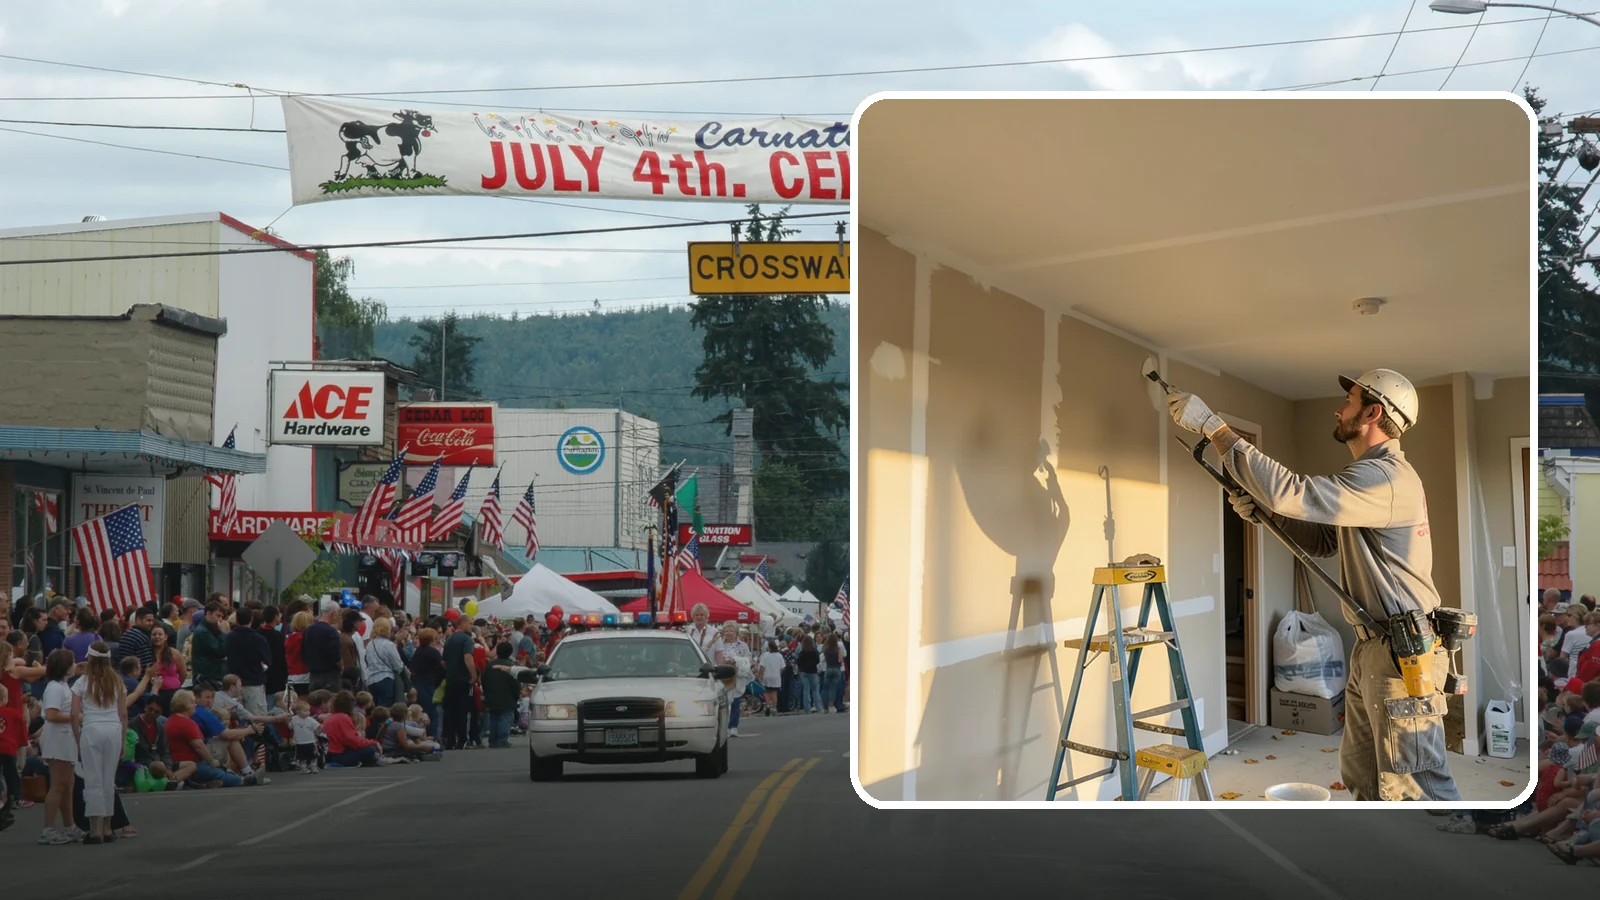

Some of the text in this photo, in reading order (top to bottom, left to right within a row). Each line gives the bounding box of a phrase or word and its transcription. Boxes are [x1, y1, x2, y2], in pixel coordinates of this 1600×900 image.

[481, 141, 605, 193] JULY
[632, 150, 747, 198] 4th.
[697, 254, 850, 280] CROSSWA
[283, 380, 373, 420] ACE
[406, 409, 452, 422] CEDAR
[283, 421, 371, 436] Hardware
[416, 428, 476, 447] Coca-Cola
[353, 467, 387, 479] Simpl
[83, 485, 155, 495] St. Vincent de Paul
[212, 516, 331, 535] HARDARE
[688, 526, 741, 535] CRNATION
[699, 535, 730, 543] GLASS
